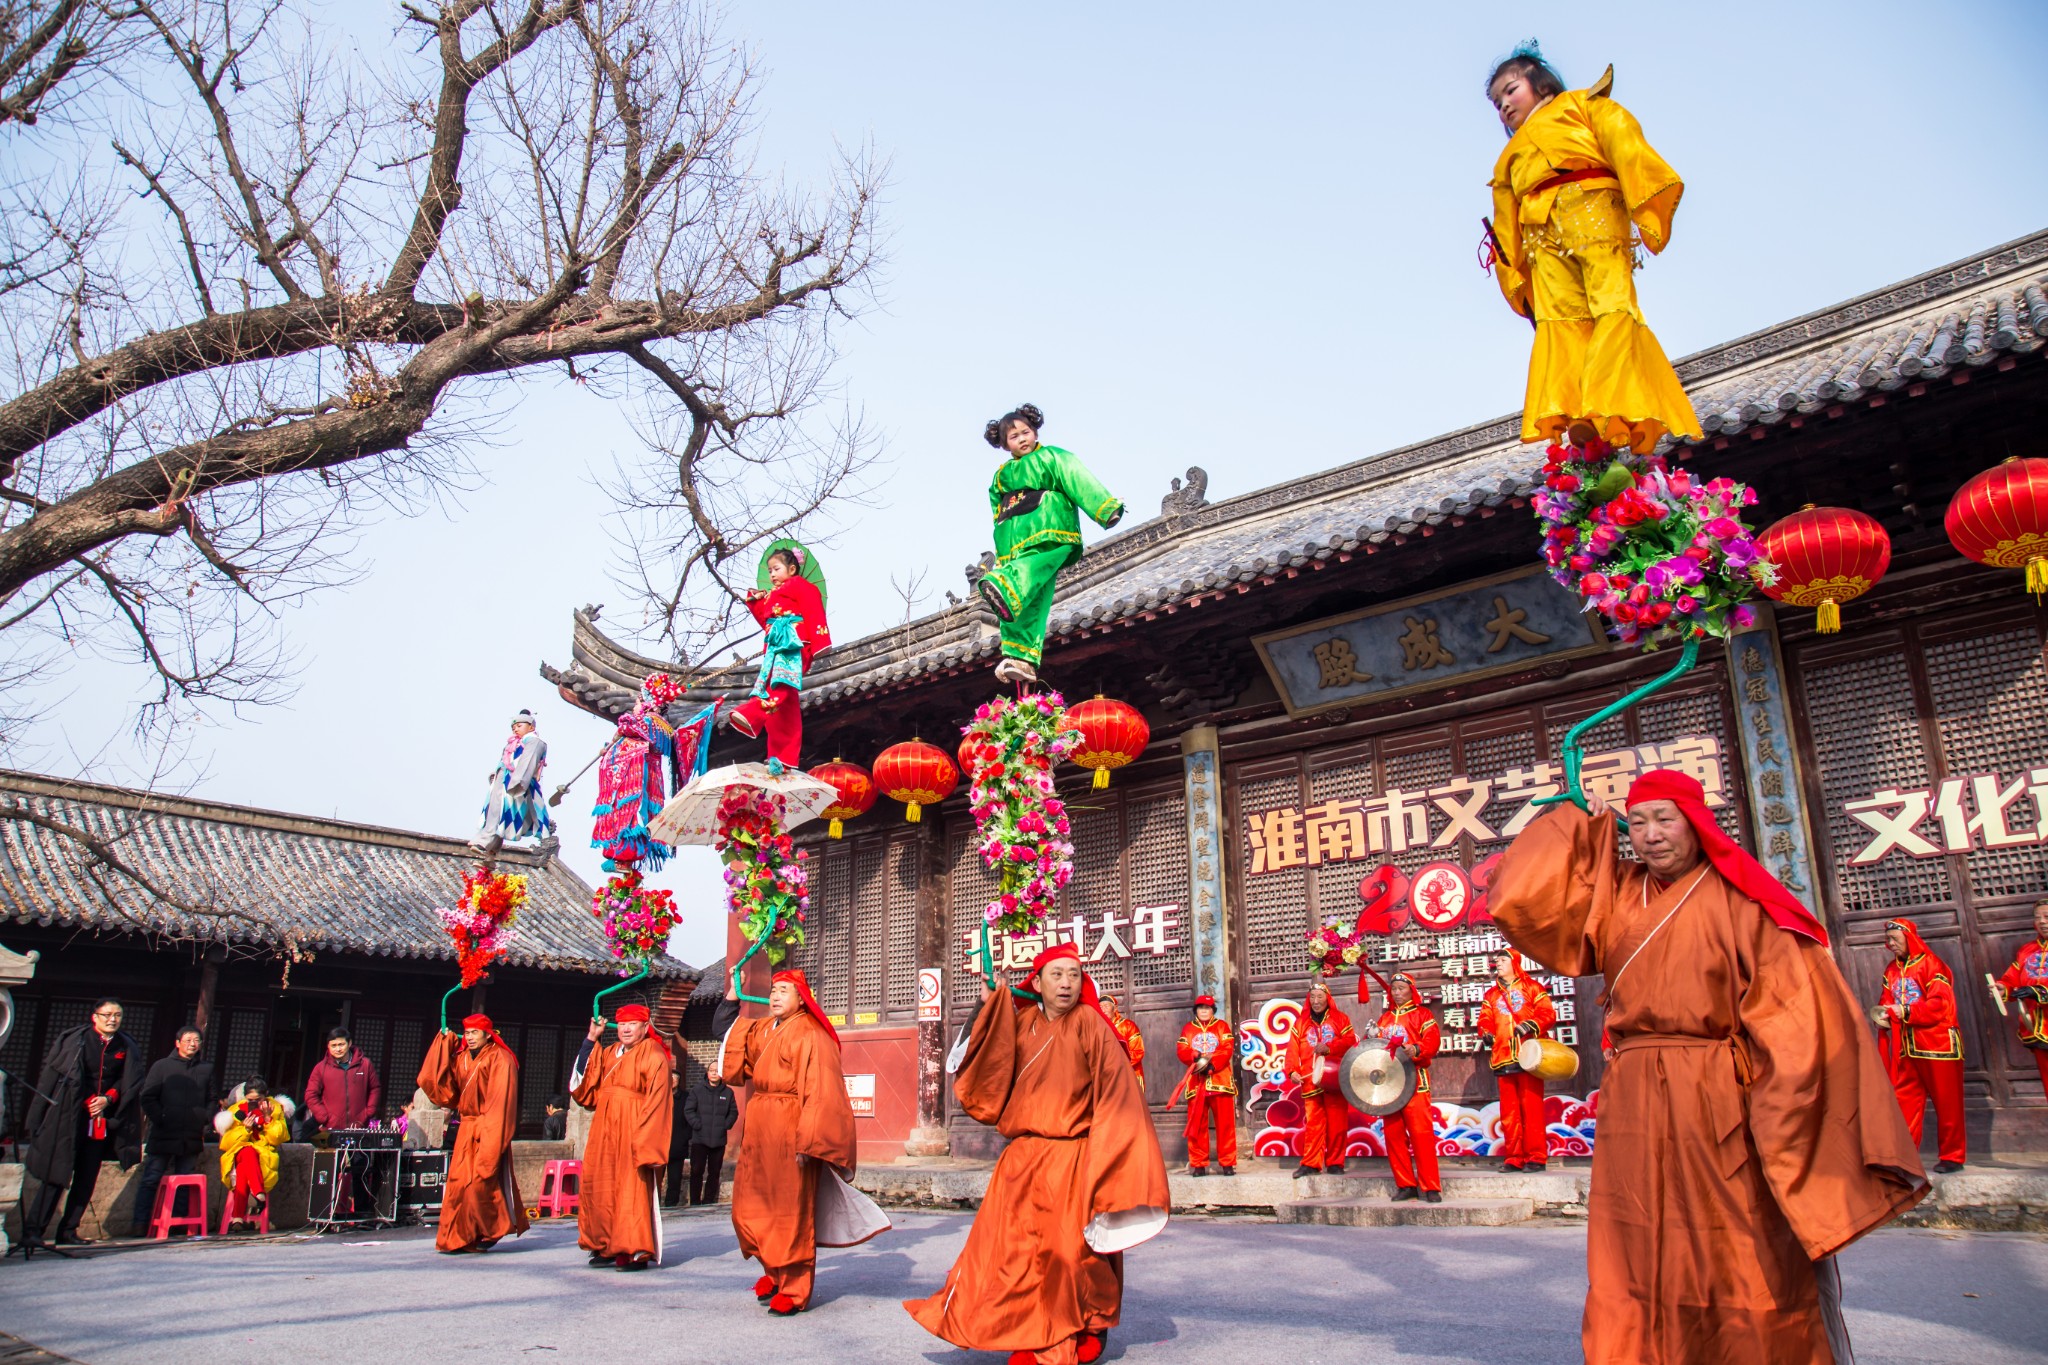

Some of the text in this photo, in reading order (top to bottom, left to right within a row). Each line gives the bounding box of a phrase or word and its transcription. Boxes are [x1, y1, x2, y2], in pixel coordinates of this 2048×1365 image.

[1313, 598, 1551, 688] 大成殿
[1845, 768, 2048, 864] 文化
